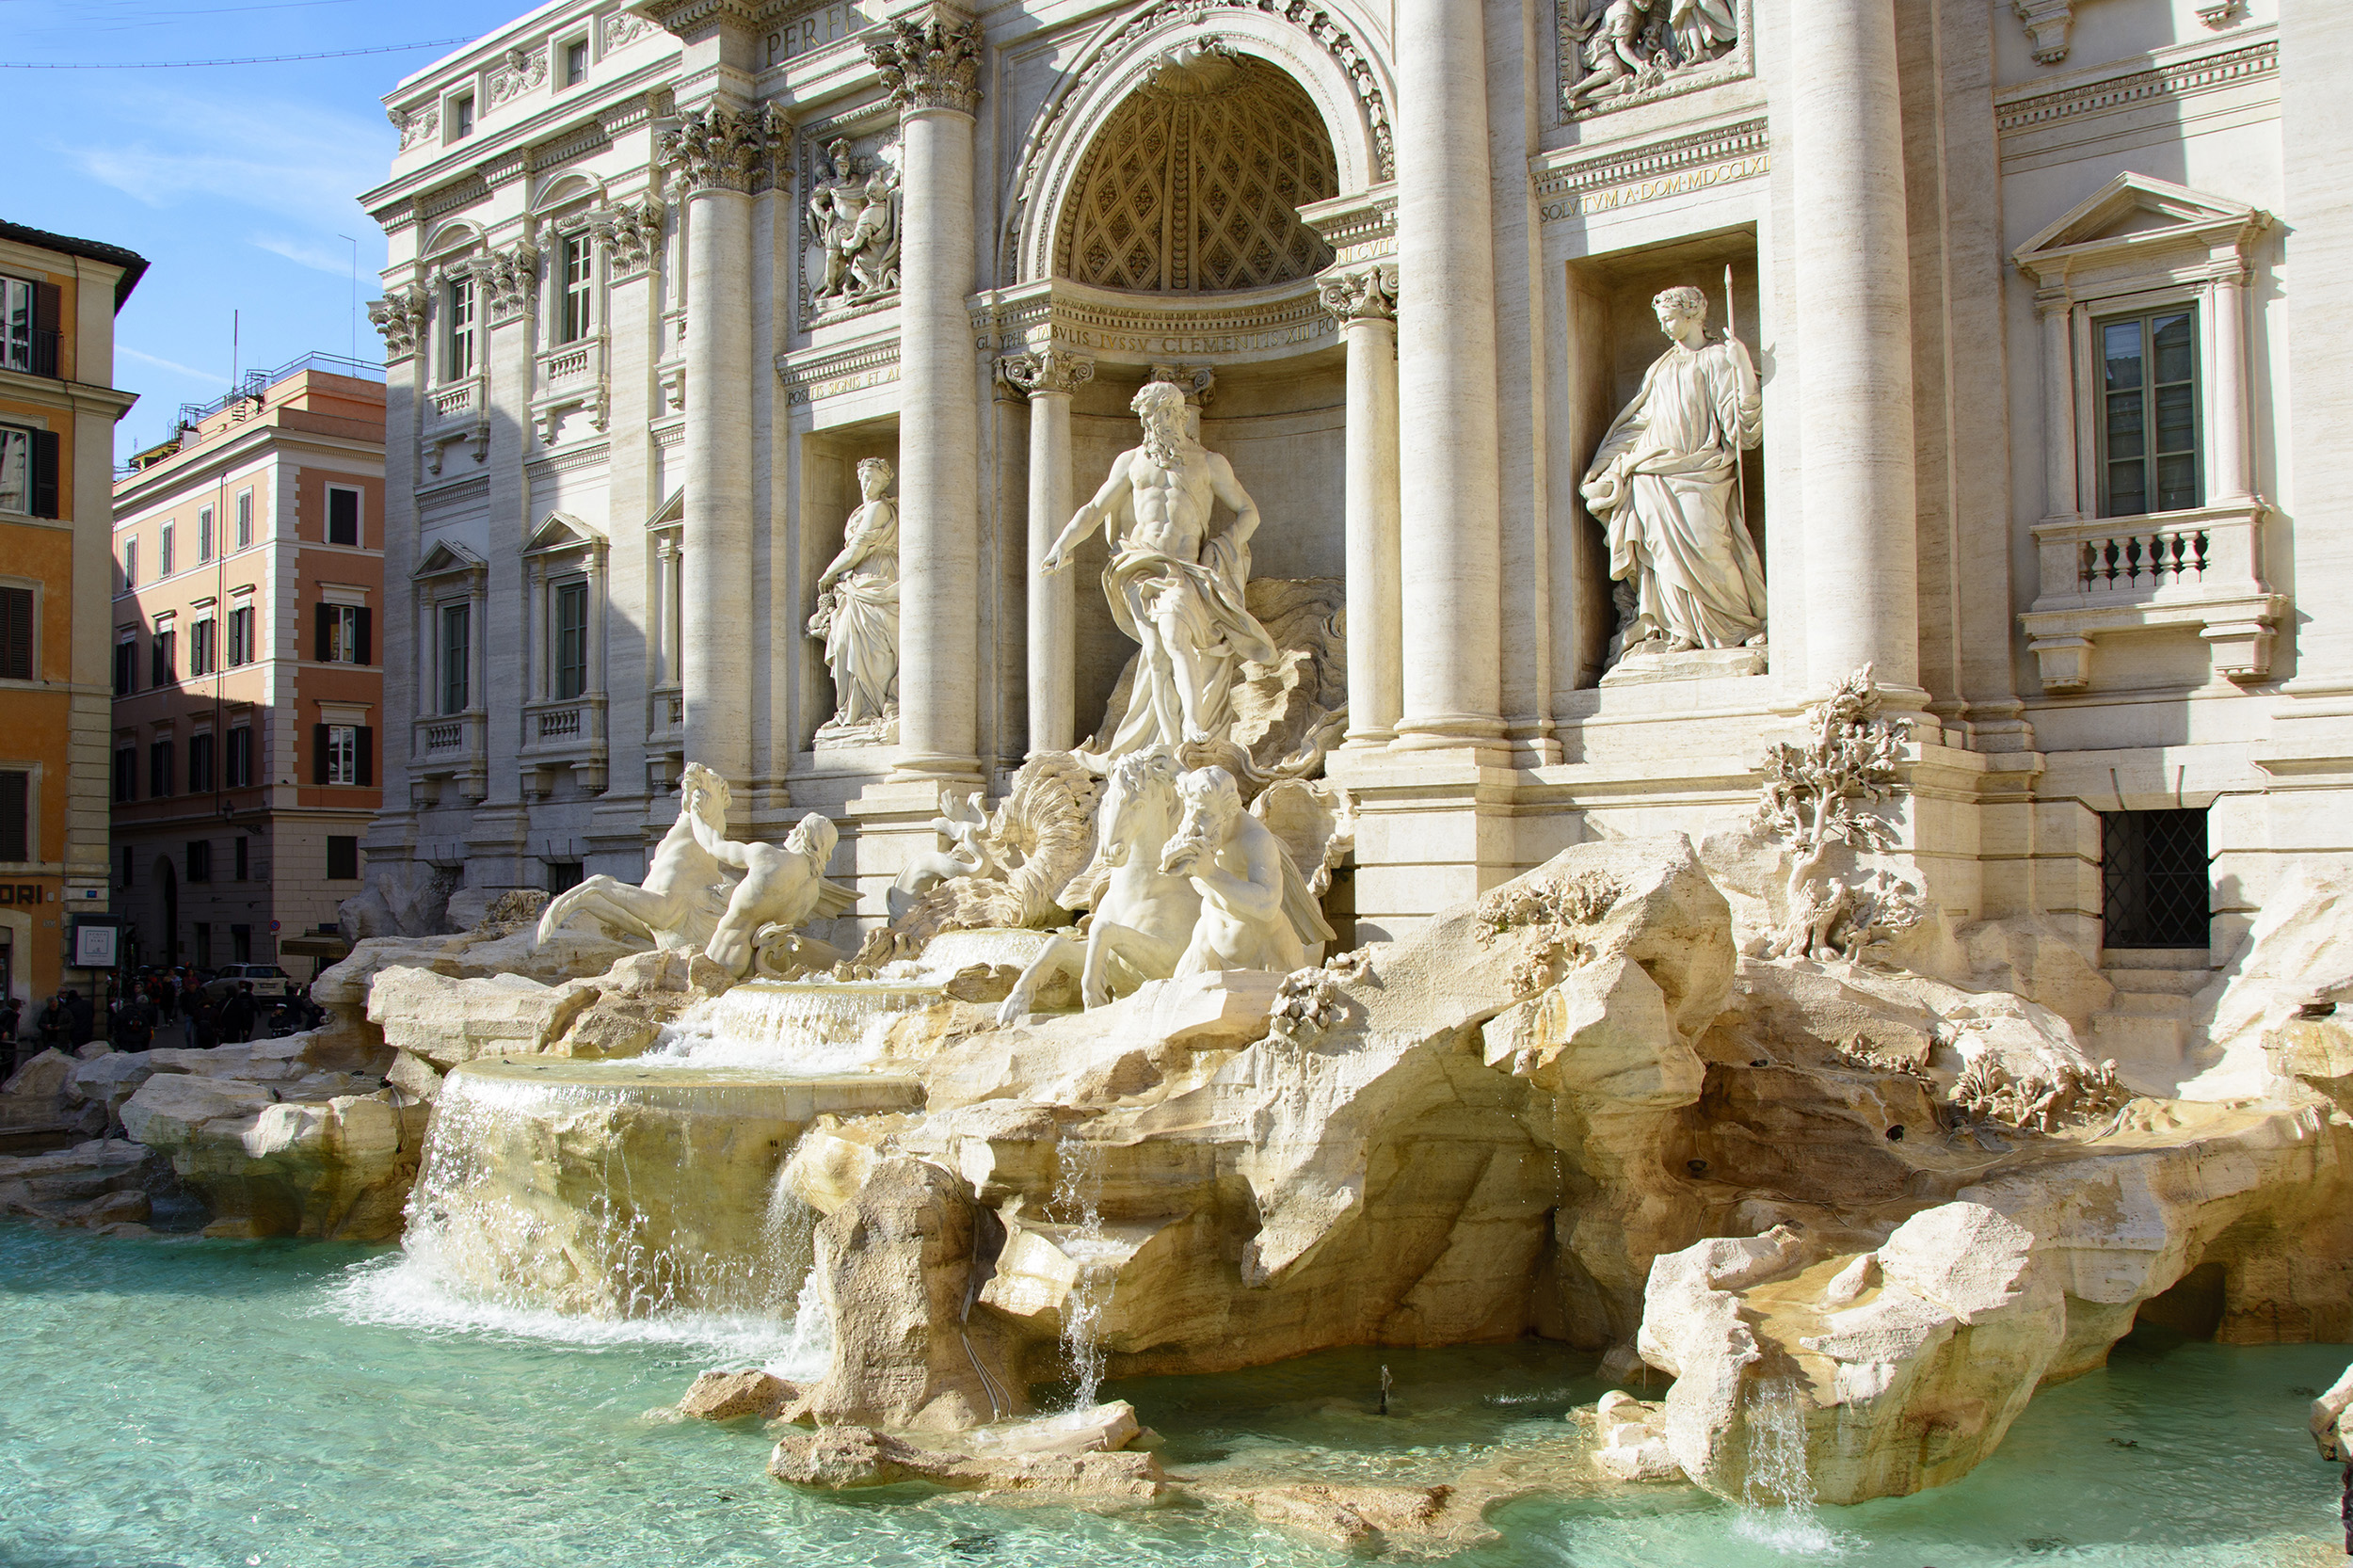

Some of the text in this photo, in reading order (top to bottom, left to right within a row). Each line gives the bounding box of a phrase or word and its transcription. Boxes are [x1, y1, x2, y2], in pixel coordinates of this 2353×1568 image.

[1541, 190, 1619, 223] SOLVTVM
[1100, 334, 1149, 351] IVSSV
[1161, 330, 1278, 353] CLEMENTIS
[788, 383, 824, 405] POSITIS
[828, 376, 860, 395] SIGNIS
[868, 370, 881, 385] ET
[0, 885, 42, 904] ORI
